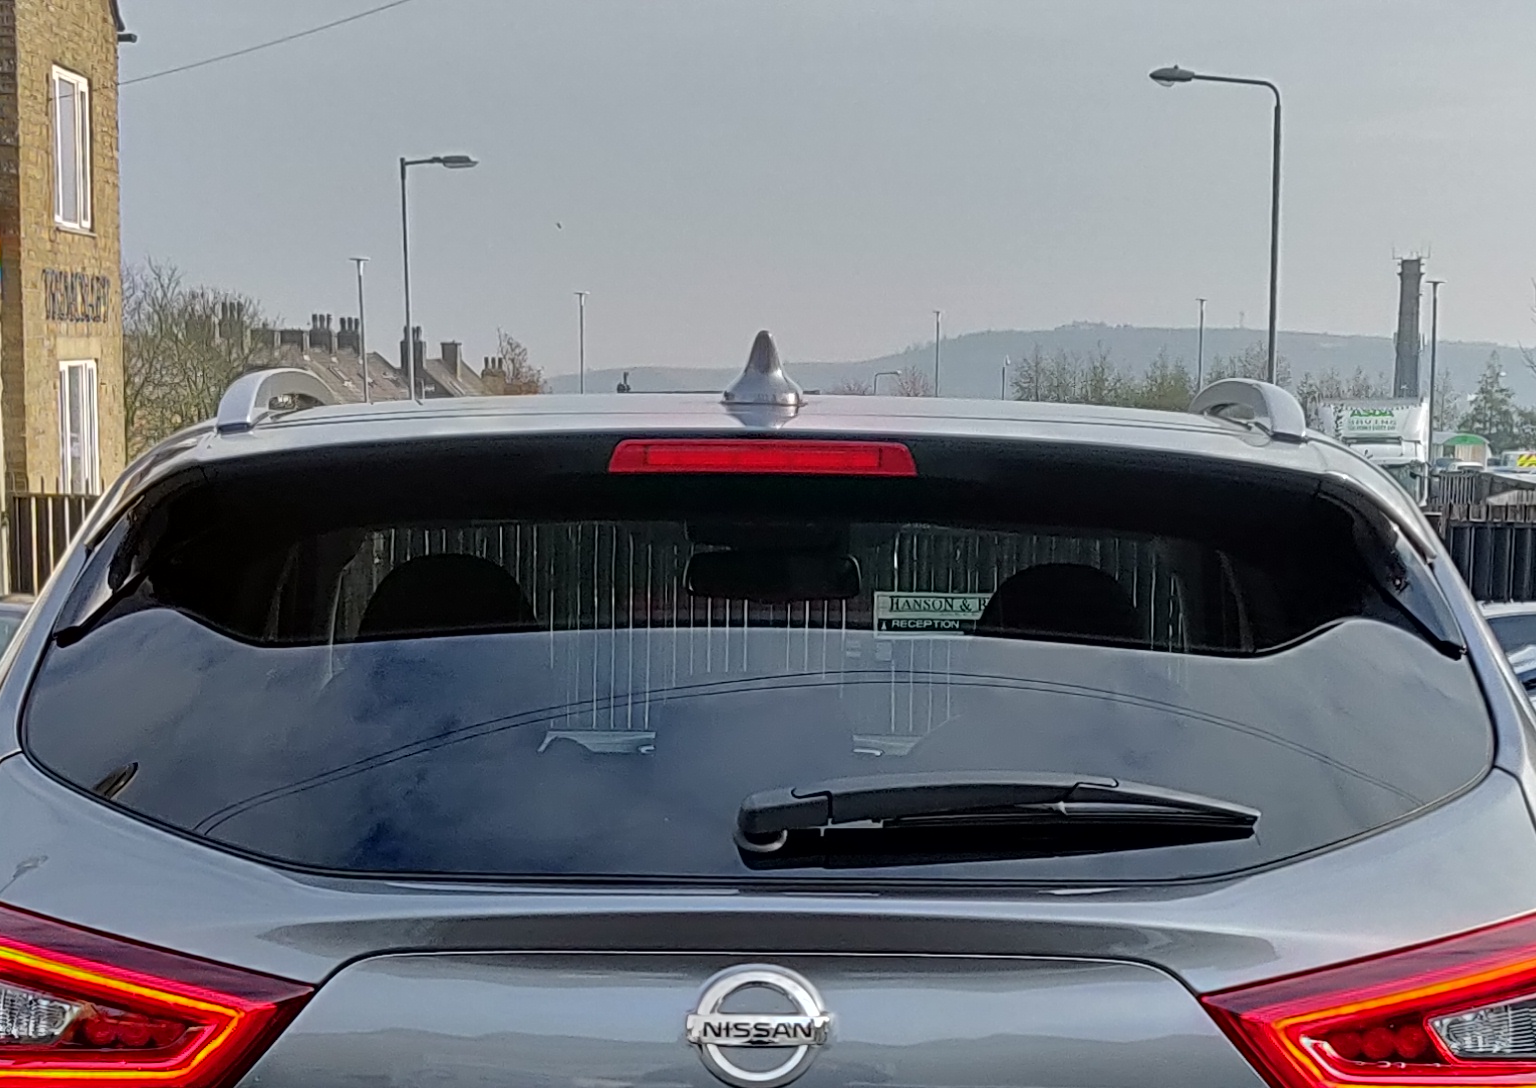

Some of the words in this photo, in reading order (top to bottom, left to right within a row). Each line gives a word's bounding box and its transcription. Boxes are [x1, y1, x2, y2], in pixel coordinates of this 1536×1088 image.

[1350, 408, 1394, 417] ASDA
[889, 596, 954, 612] HANSON
[960, 599, 972, 612] &
[891, 619, 960, 629] RECEPTION
[703, 1021, 812, 1038] NISSAN
